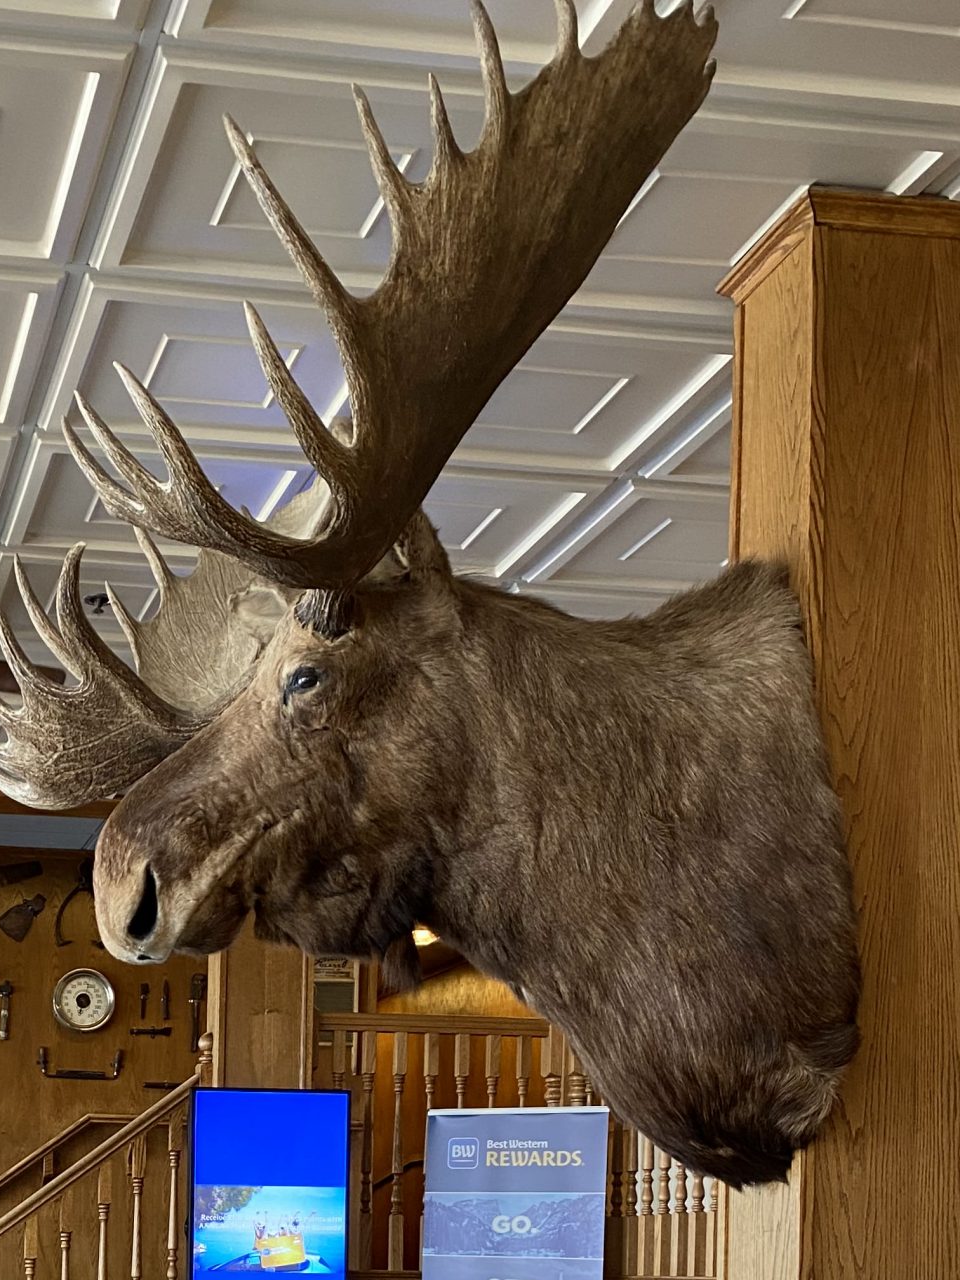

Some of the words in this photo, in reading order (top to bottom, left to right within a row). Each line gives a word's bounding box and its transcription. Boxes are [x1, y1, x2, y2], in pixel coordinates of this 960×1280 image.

[452, 1144, 475, 1158] BW
[486, 1139, 507, 1149] Best
[509, 1140, 548, 1149] Western
[486, 1150, 582, 1167] REWARDS
[492, 1215, 538, 1234] GO.
